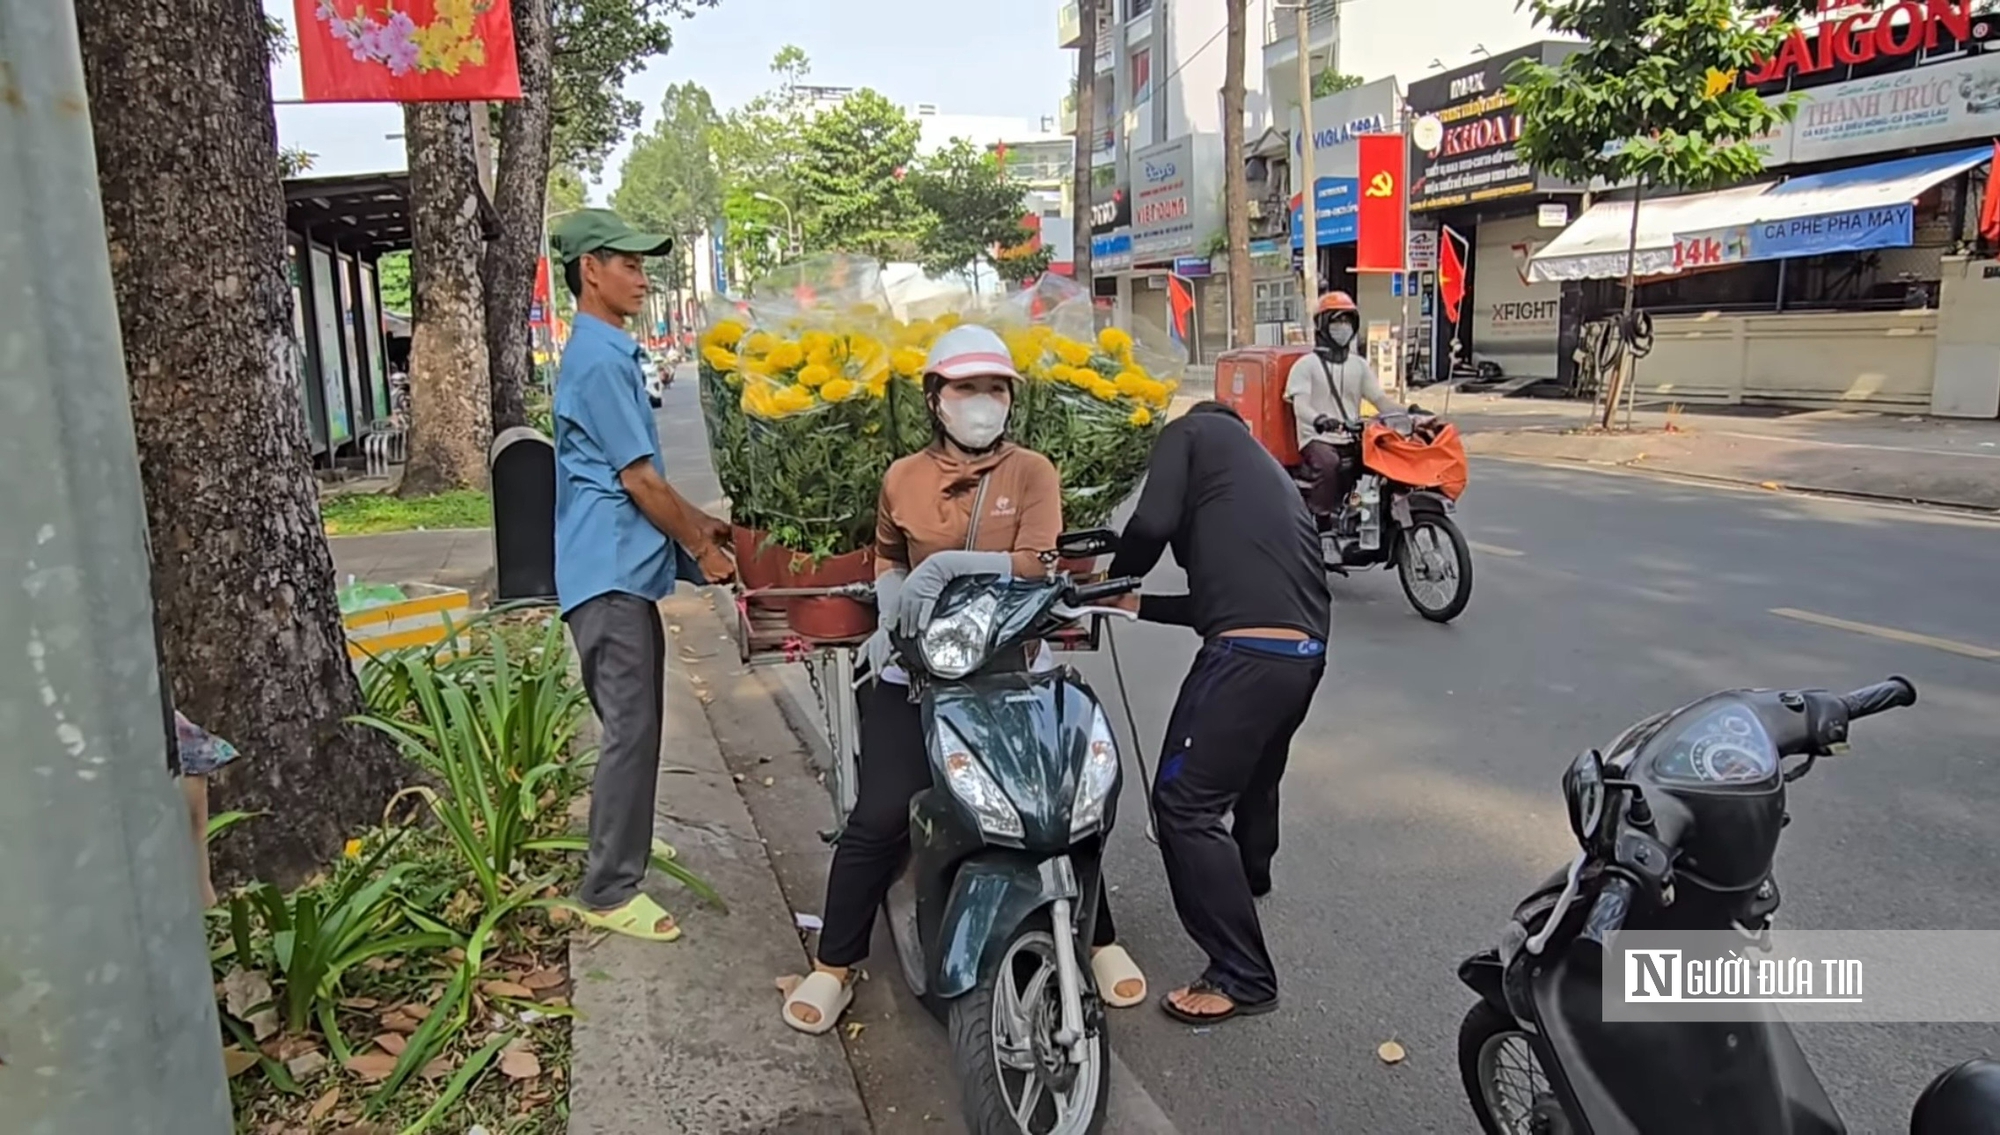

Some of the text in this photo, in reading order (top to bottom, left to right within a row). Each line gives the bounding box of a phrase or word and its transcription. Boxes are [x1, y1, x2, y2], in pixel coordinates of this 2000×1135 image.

[1745, 0, 1971, 85] SAIGON
[1805, 76, 1953, 128] THANH TRÚC
[1828, 213, 1863, 232] PHA
[1492, 300, 1558, 321] XFIGHT
